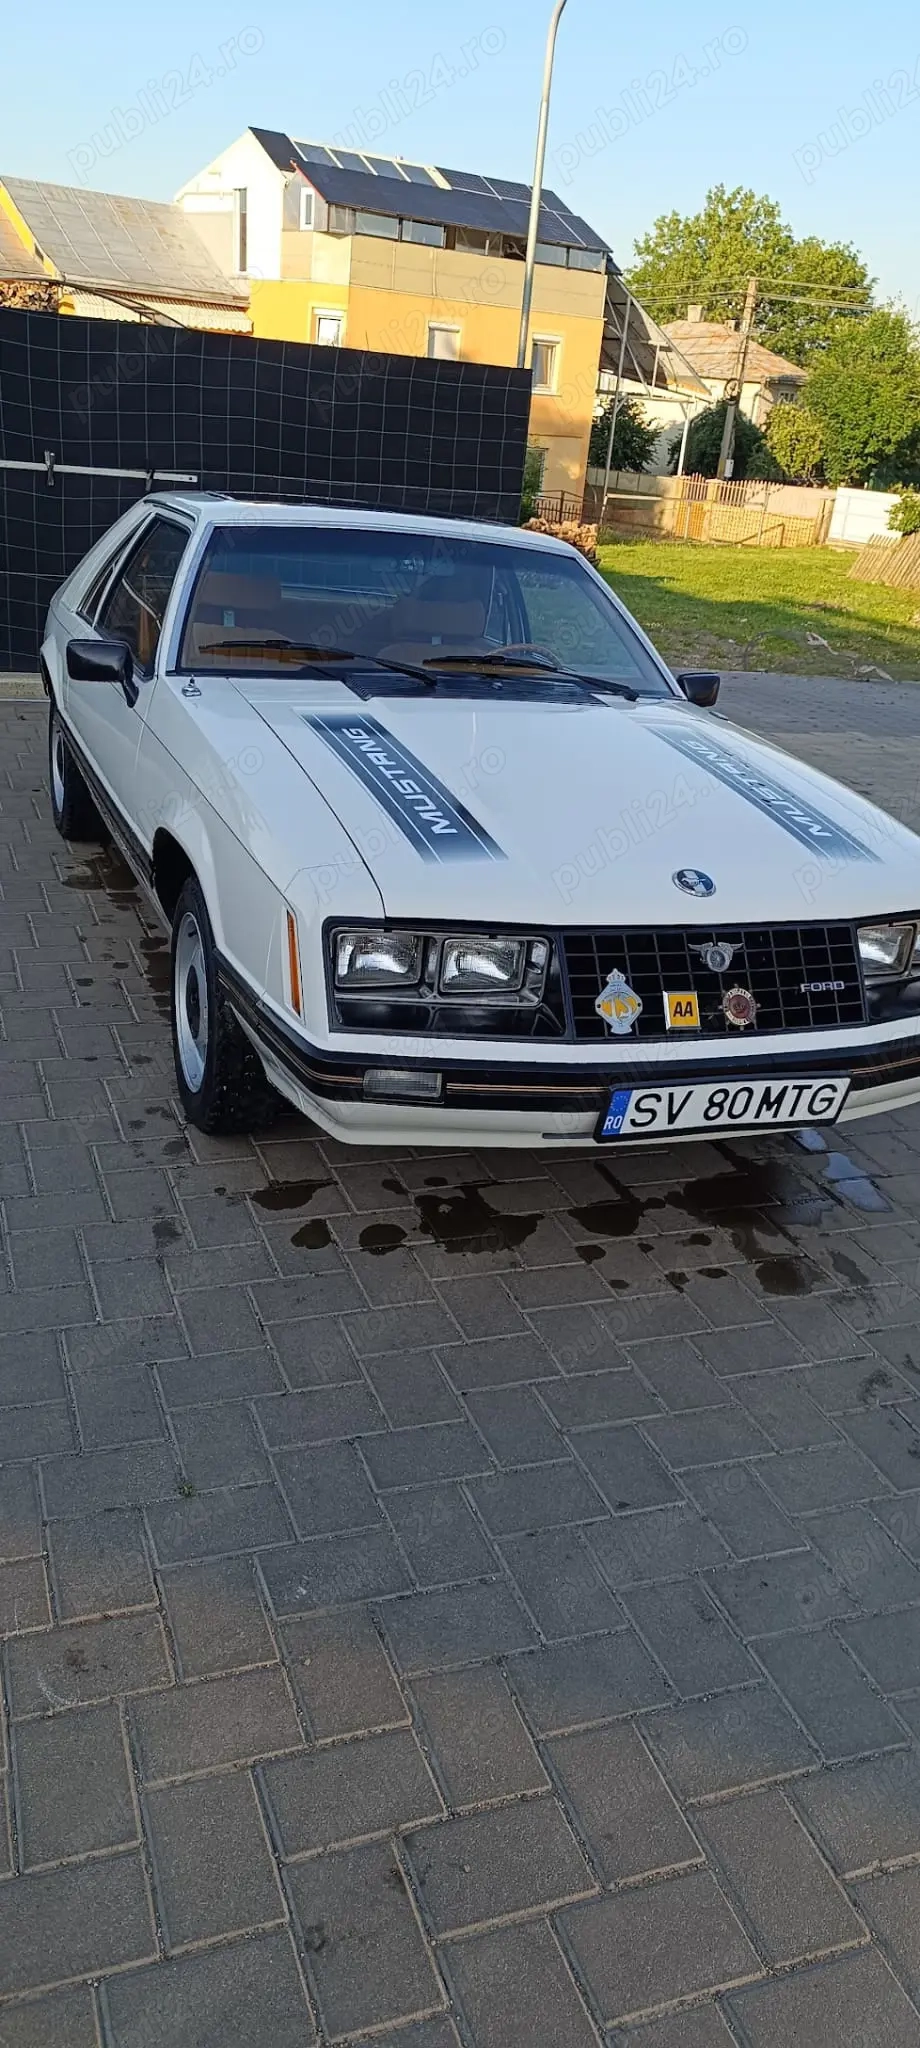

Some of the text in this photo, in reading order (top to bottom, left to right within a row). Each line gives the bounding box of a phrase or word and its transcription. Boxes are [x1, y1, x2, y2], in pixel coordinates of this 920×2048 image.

[341, 728, 458, 834] MUSTANG
[681, 738, 833, 837] MUSTANG
[800, 981, 845, 993] FORD
[673, 1001, 693, 1017] AA
[629, 1090, 694, 1128] SV
[603, 1116, 623, 1130] RO
